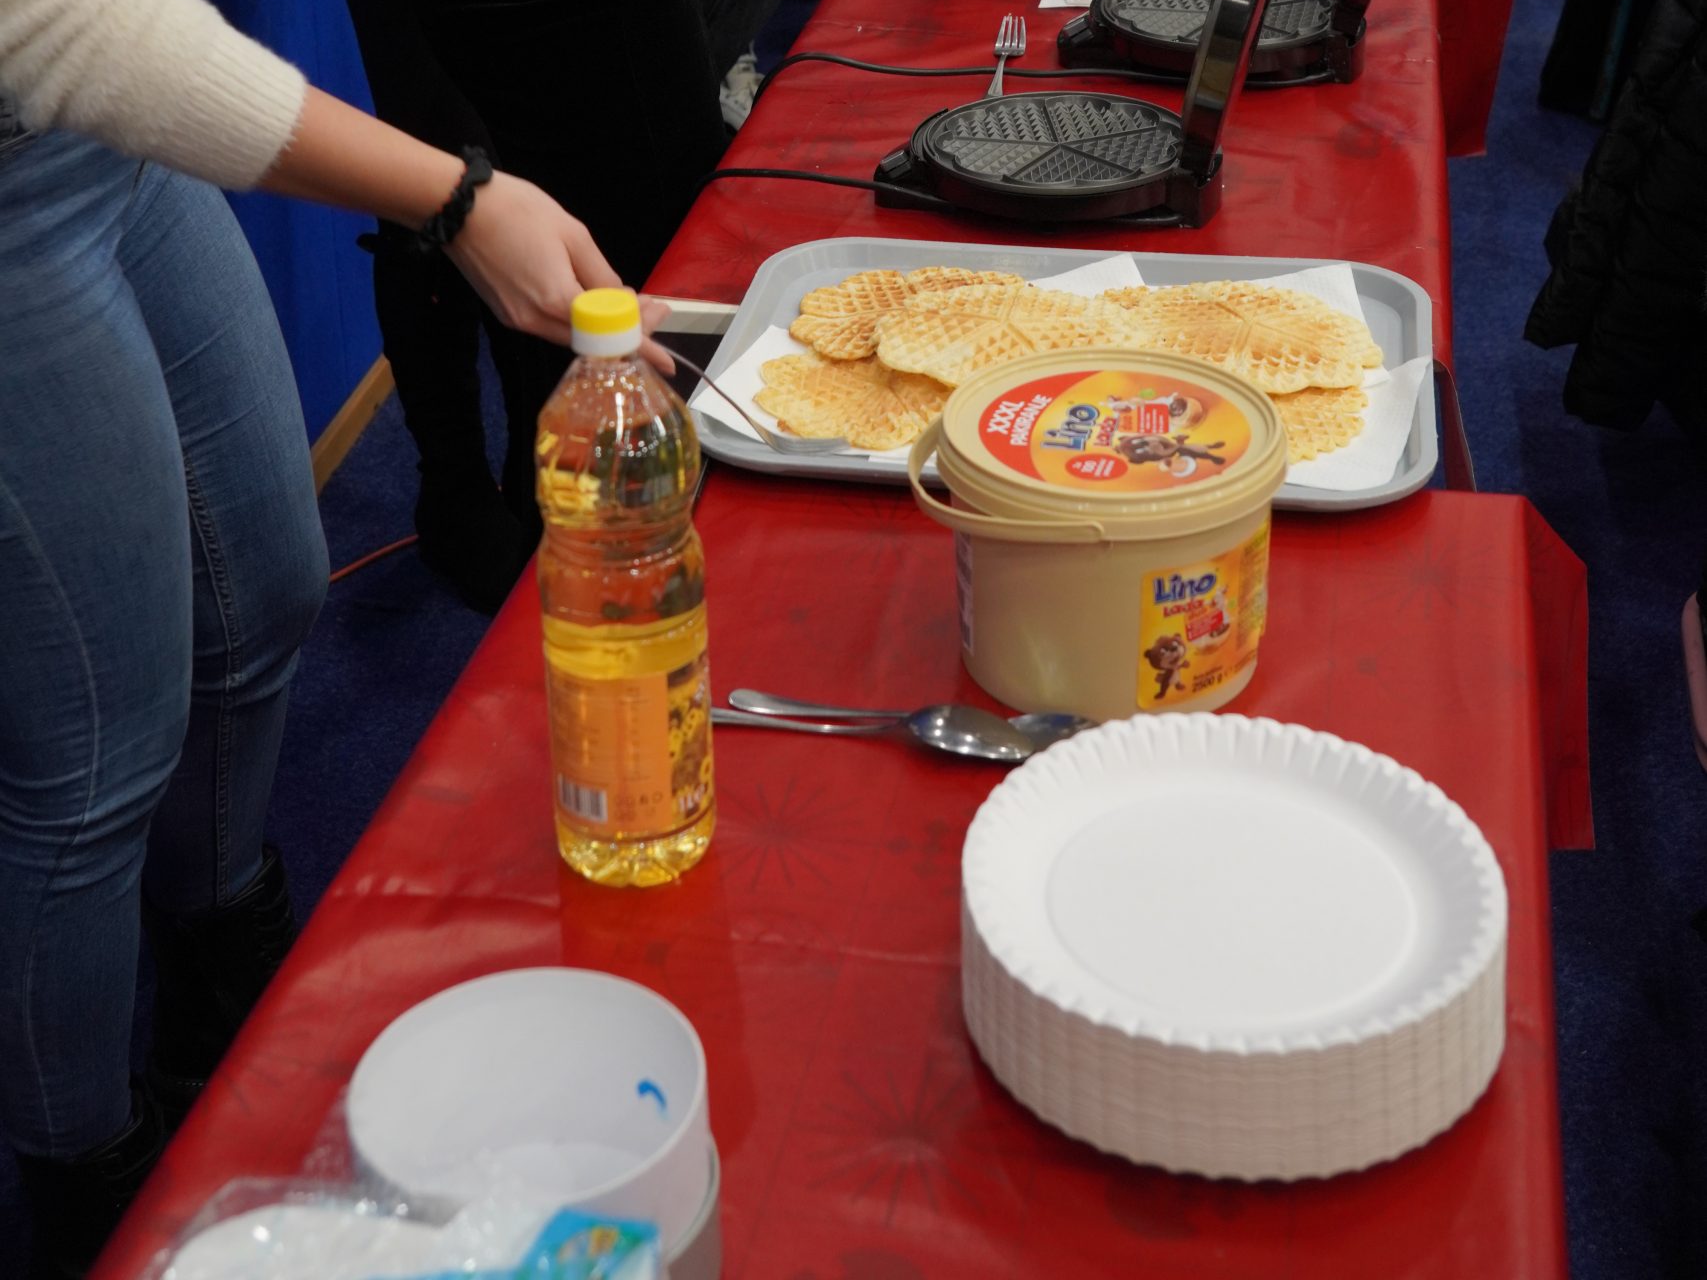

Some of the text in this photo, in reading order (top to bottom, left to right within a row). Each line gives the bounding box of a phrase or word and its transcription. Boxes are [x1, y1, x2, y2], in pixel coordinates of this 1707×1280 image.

[986, 400, 1025, 435] XXXL
[1009, 394, 1053, 447] PAKIRANJE
[1040, 404, 1101, 451] Lino
[1153, 573, 1217, 605] Lino
